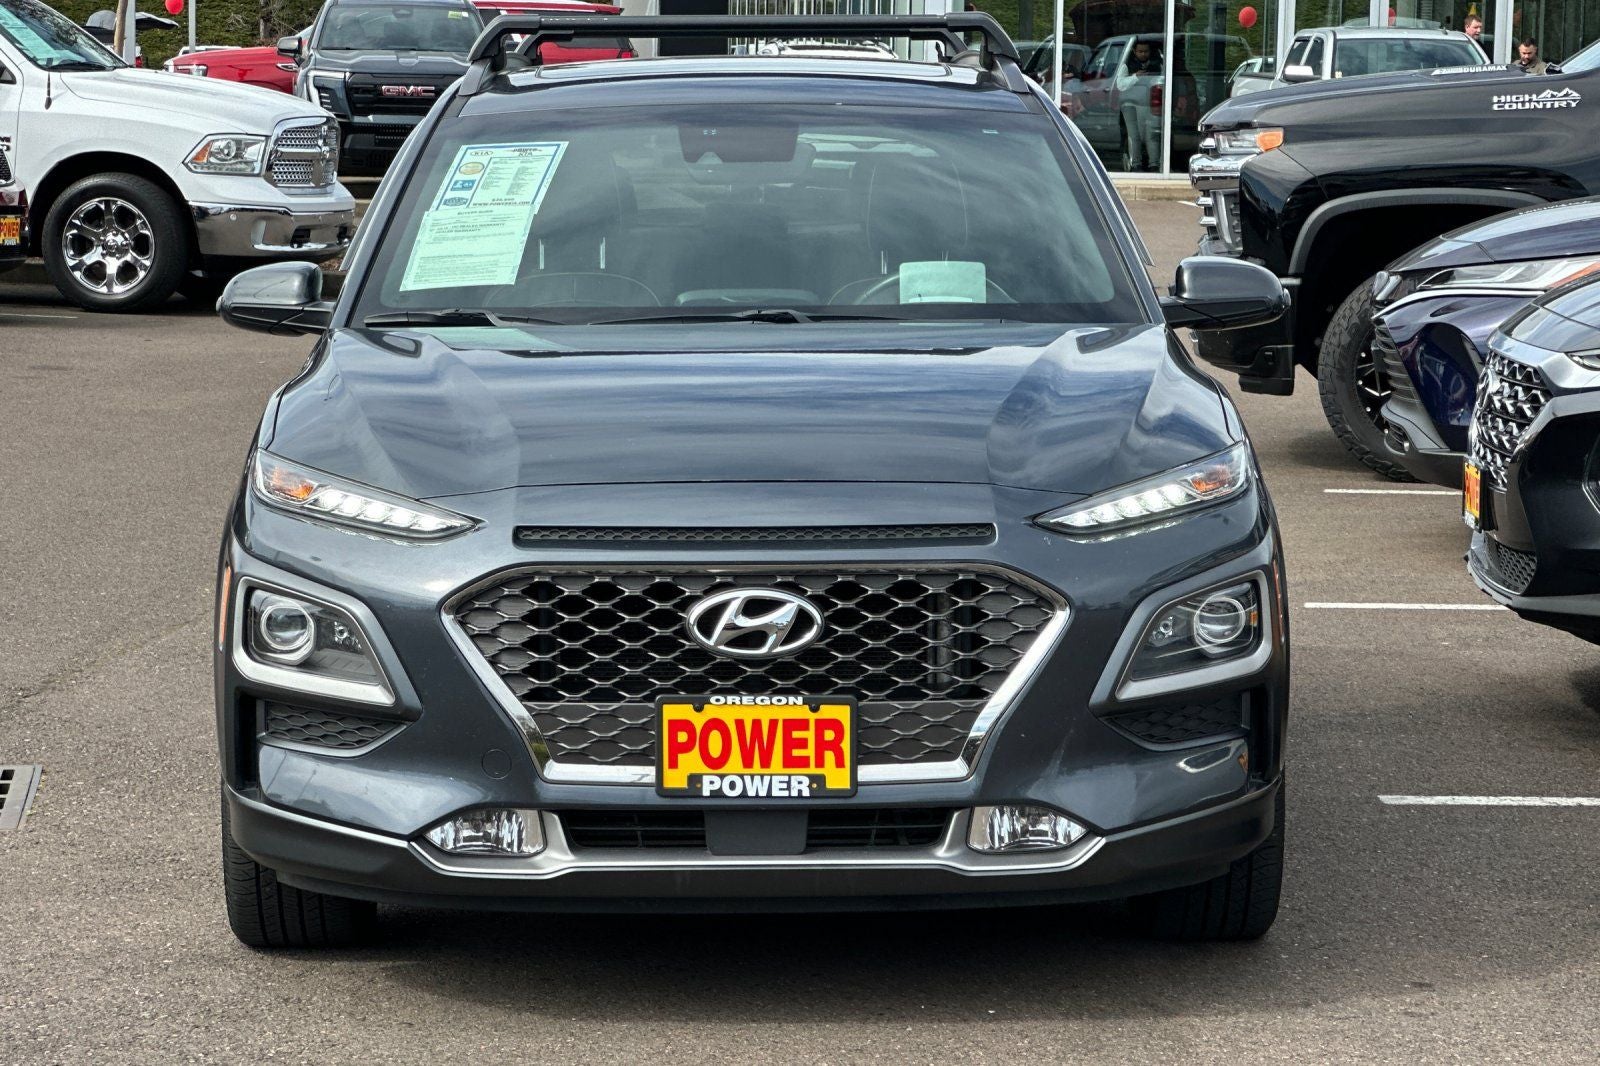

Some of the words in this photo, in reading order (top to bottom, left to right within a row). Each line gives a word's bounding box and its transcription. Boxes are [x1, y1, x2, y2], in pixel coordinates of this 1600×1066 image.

[1463, 65, 1507, 73] DURAMAX
[382, 85, 435, 96] GMC
[1493, 93, 1537, 103] HIGH
[1492, 100, 1580, 111] COUNTRY
[709, 695, 804, 706] OREGON
[667, 717, 846, 771] POWER
[702, 775, 811, 797] POWER
